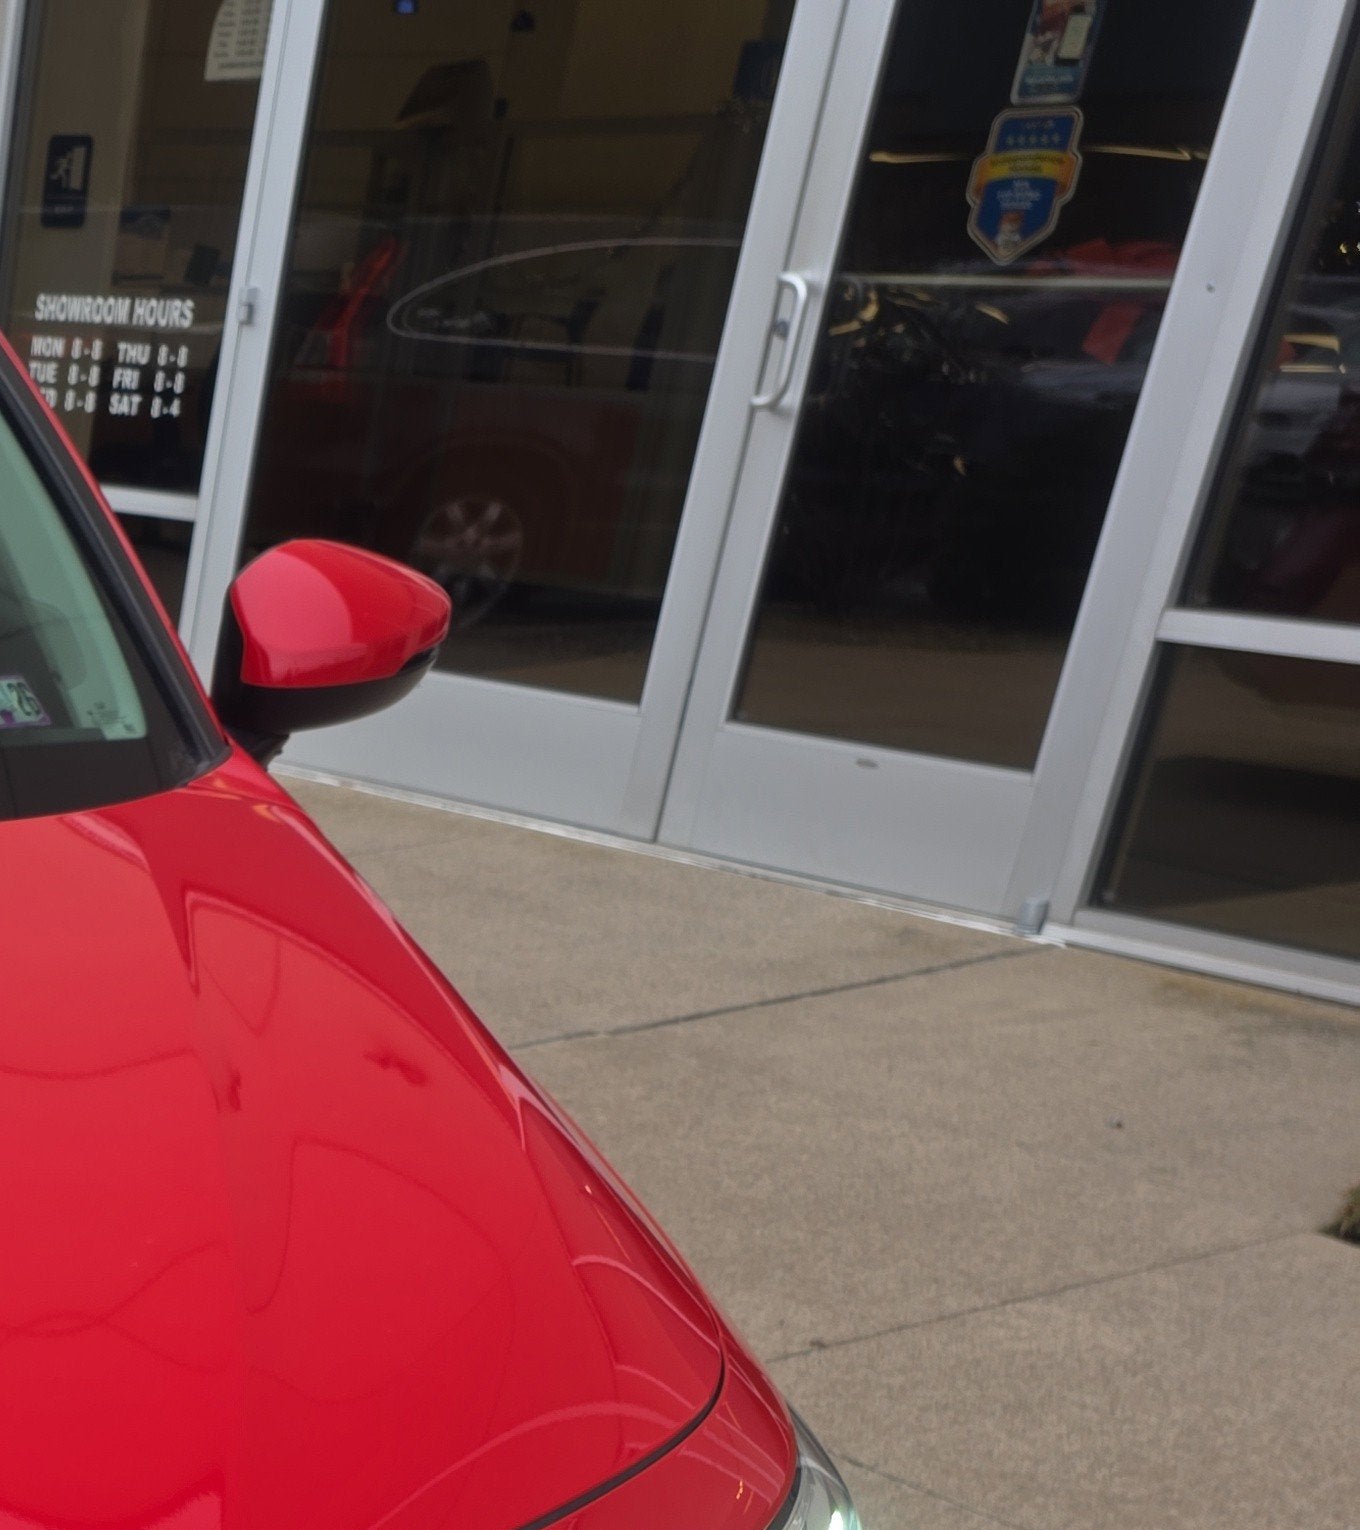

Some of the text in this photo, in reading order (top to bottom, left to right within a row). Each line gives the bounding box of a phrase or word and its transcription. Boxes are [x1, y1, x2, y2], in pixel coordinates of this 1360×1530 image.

[35, 293, 195, 328] SHOWROOM HOURS
[30, 335, 65, 357] MON
[117, 342, 151, 365] THU
[29, 361, 58, 384] TUE
[112, 367, 140, 390] FRI
[108, 392, 143, 416] SAT
